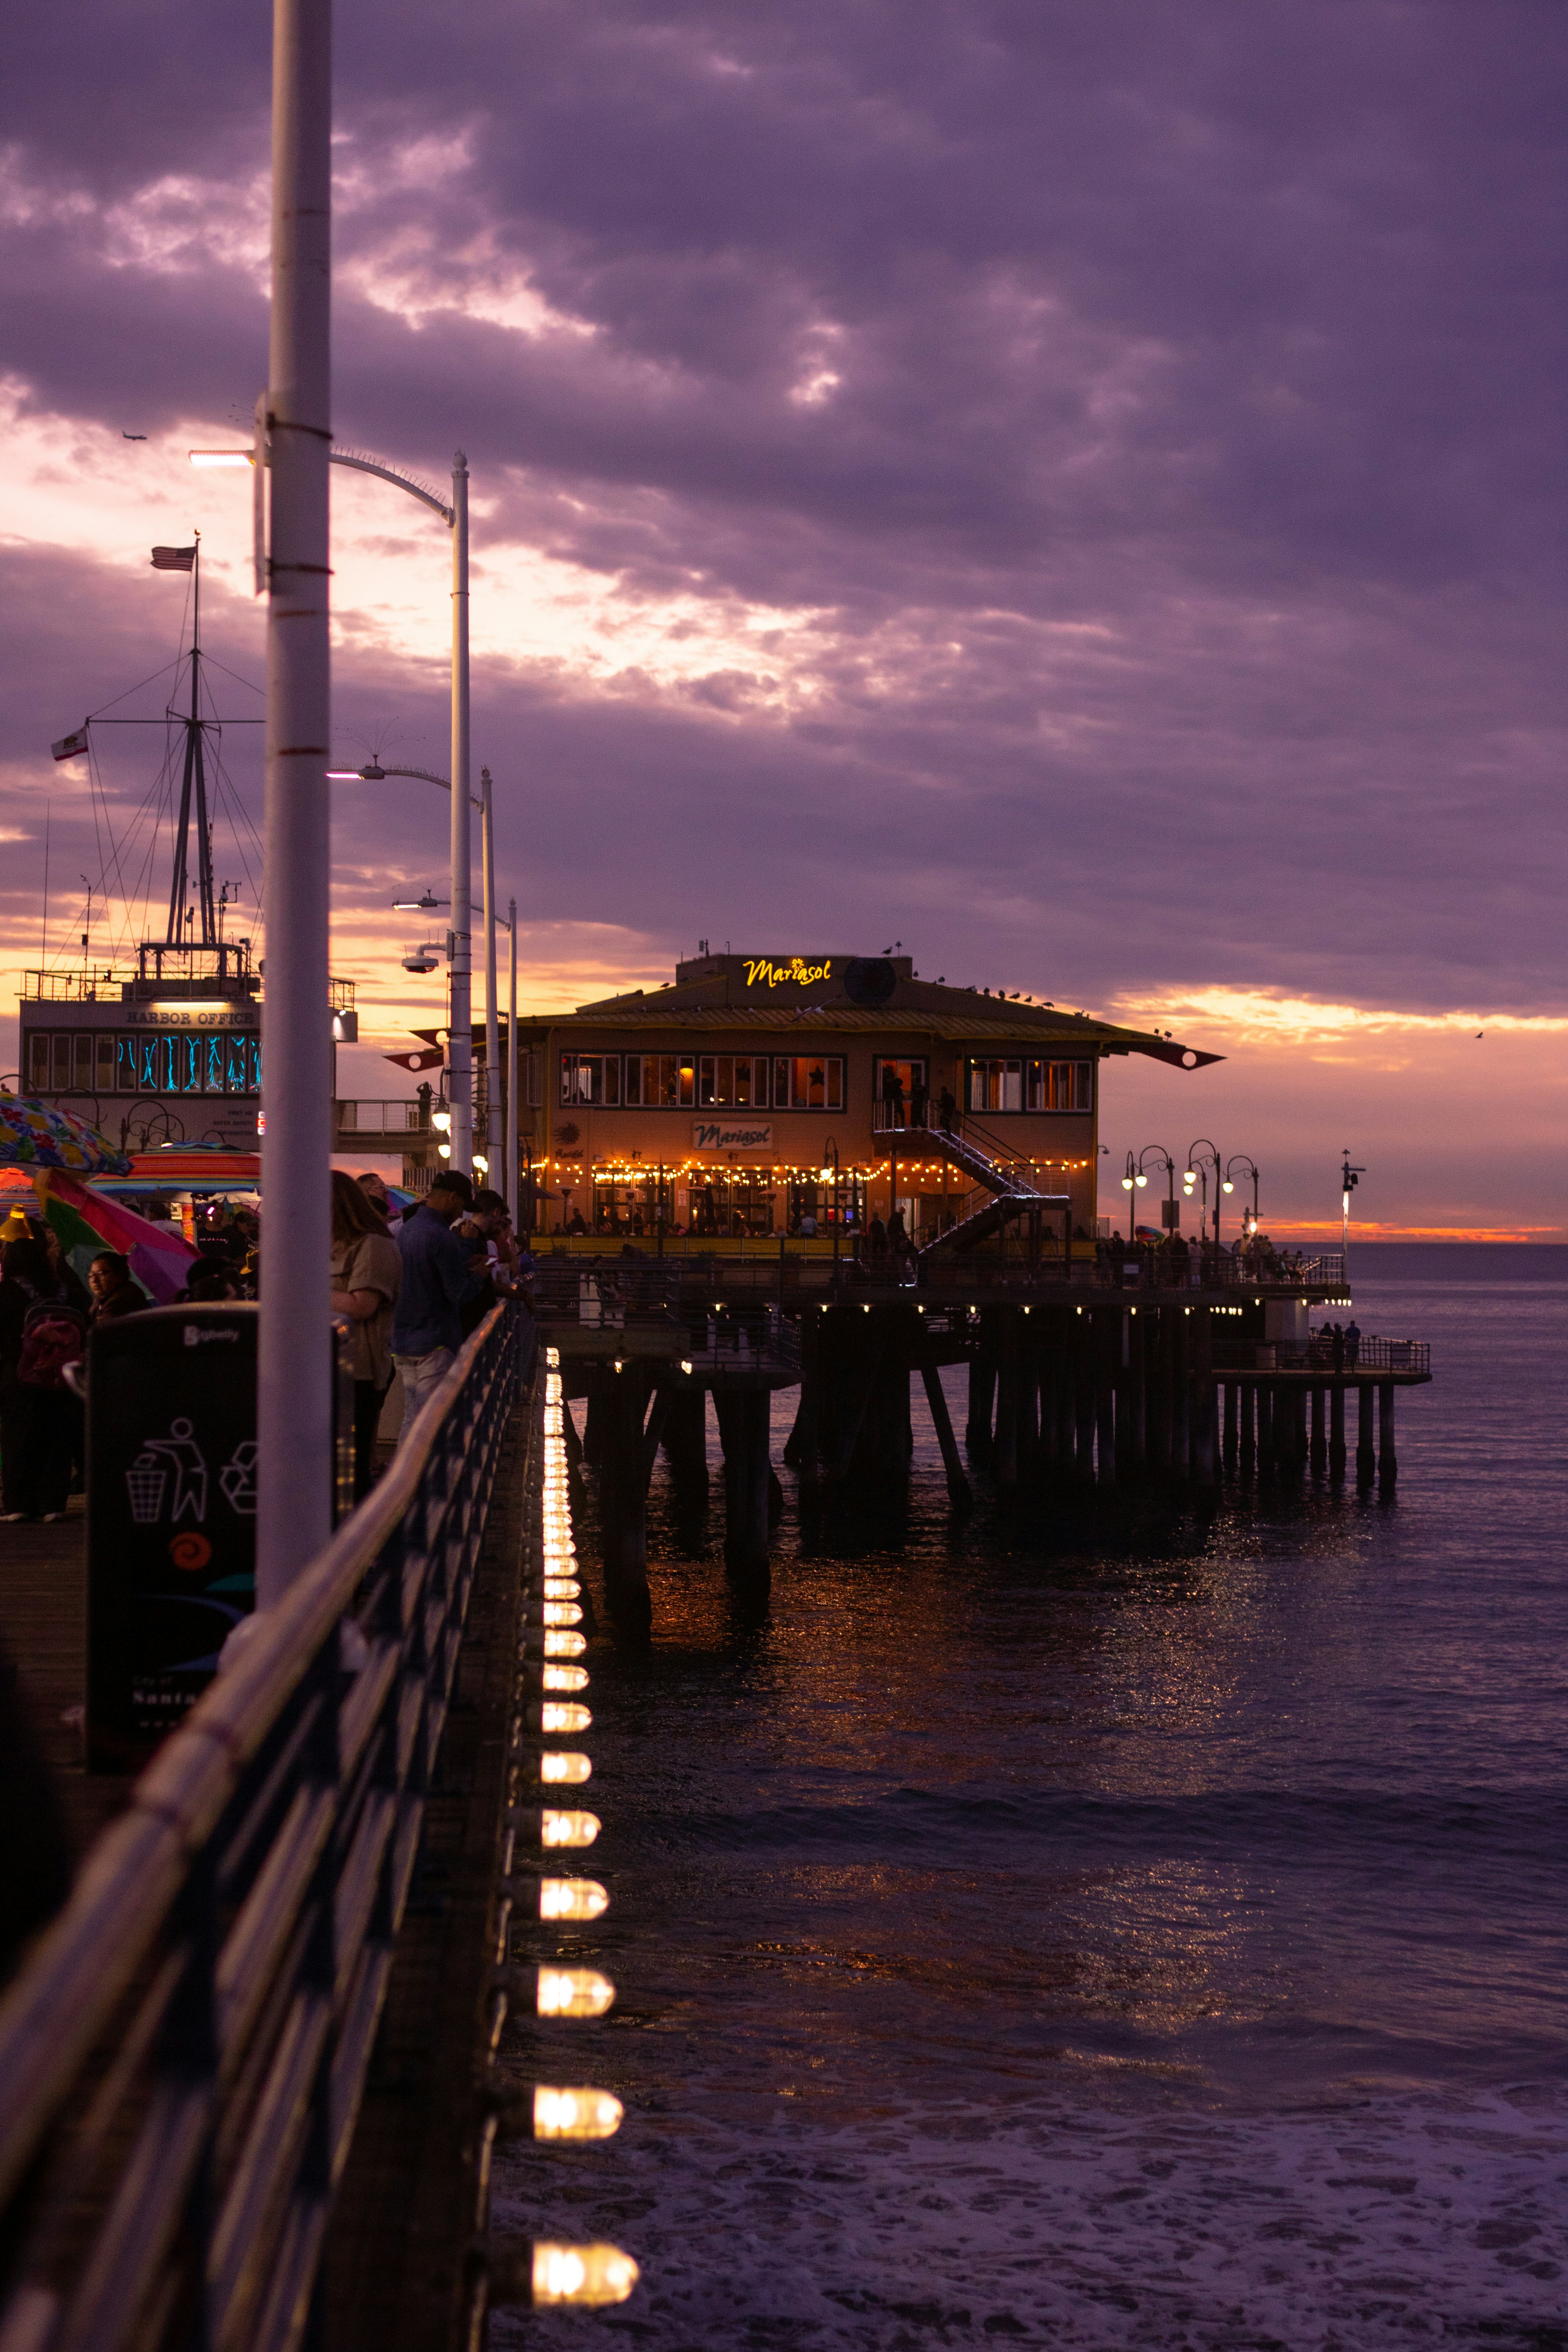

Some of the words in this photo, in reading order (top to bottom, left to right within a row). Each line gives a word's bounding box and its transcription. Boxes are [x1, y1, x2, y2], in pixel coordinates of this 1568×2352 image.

[743, 960, 831, 987] Mariasol
[127, 1012, 191, 1025] HARBOR
[198, 1012, 254, 1025] OFFICE
[695, 1124, 770, 1148] Mariasol
